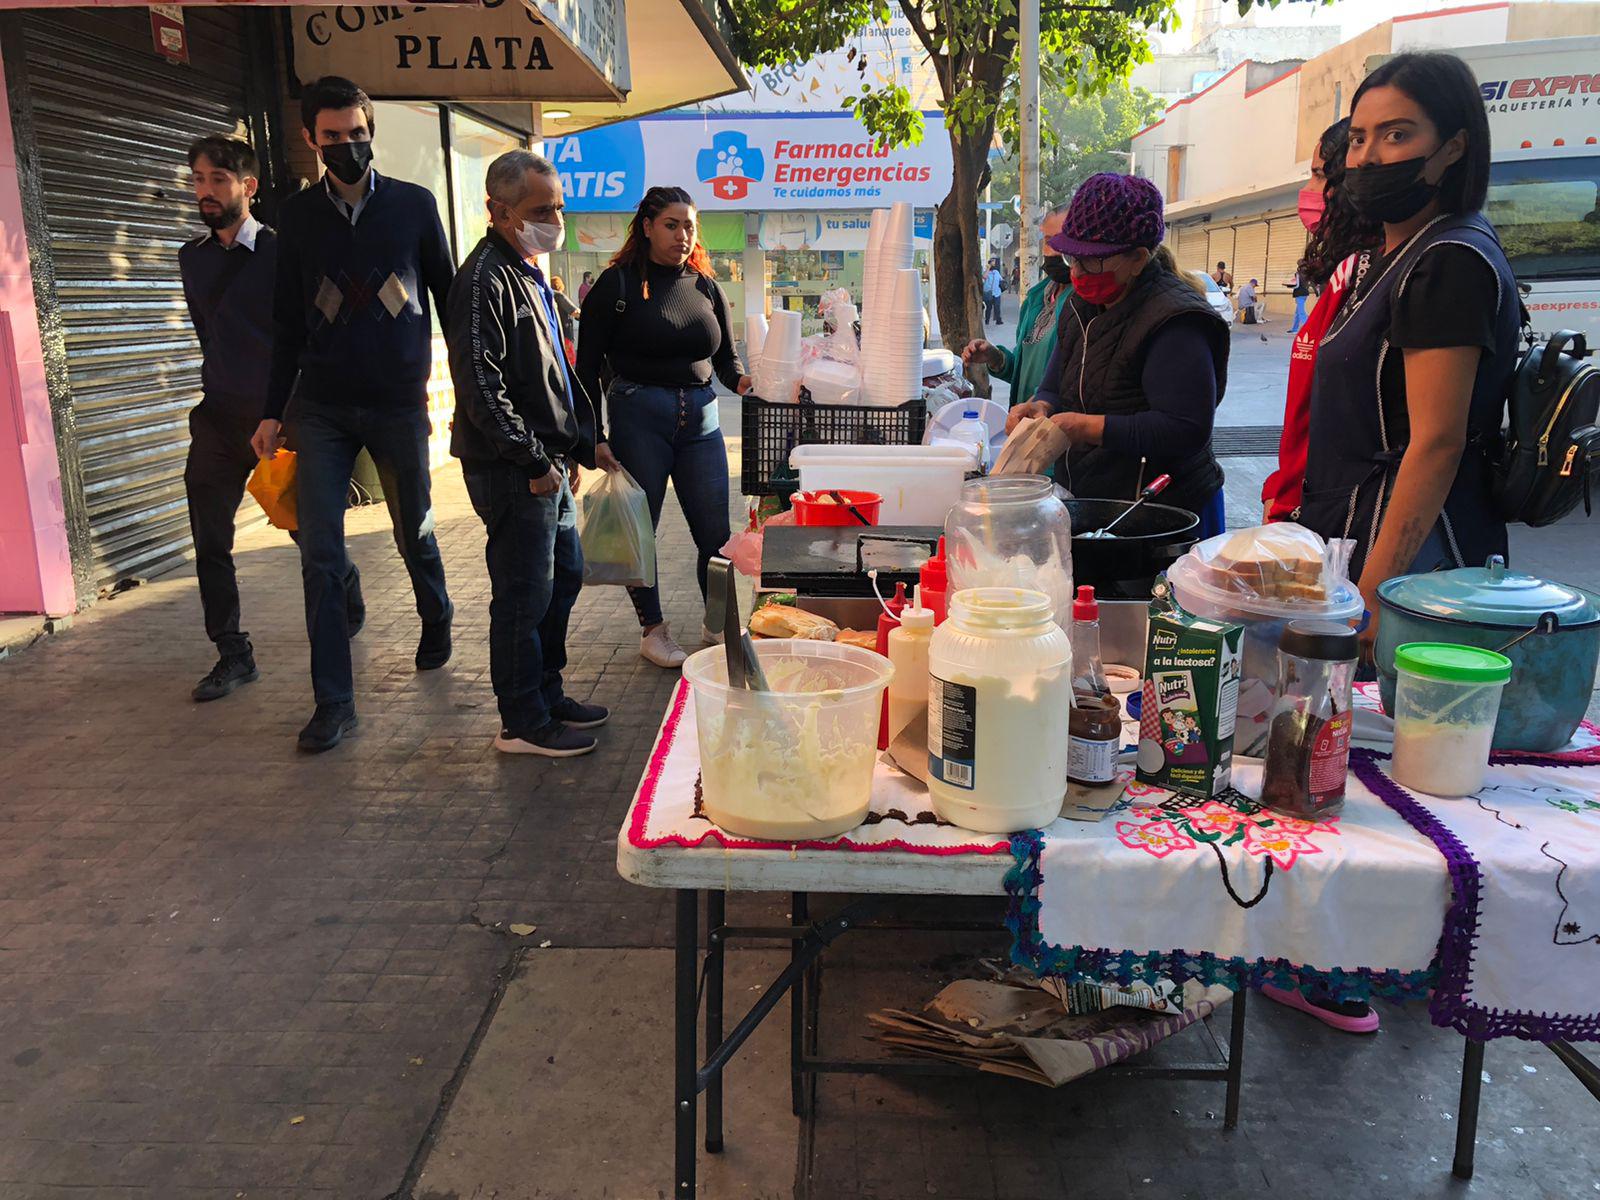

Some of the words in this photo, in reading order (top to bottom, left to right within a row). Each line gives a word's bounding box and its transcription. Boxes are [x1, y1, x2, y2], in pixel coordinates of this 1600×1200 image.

[394, 35, 554, 70] PLATA
[1485, 97, 1573, 114] AQUETERÍA
[1582, 97, 1590, 106] Y
[544, 136, 582, 163] TA
[774, 139, 890, 160] Farmacia
[774, 162, 932, 188] Emergencias
[561, 171, 626, 198] ATIS
[773, 187, 787, 198] Te
[790, 187, 851, 198] cuidamos
[854, 186, 881, 197] más
[826, 219, 840, 229] tu
[1292, 350, 1313, 361] adida
[1153, 635, 1178, 645] Nutri
[1177, 647, 1217, 656] ¿Intolerante
[1162, 656, 1172, 666] la
[1174, 657, 1216, 667] lactosa?
[1159, 674, 1188, 694] Nutri
